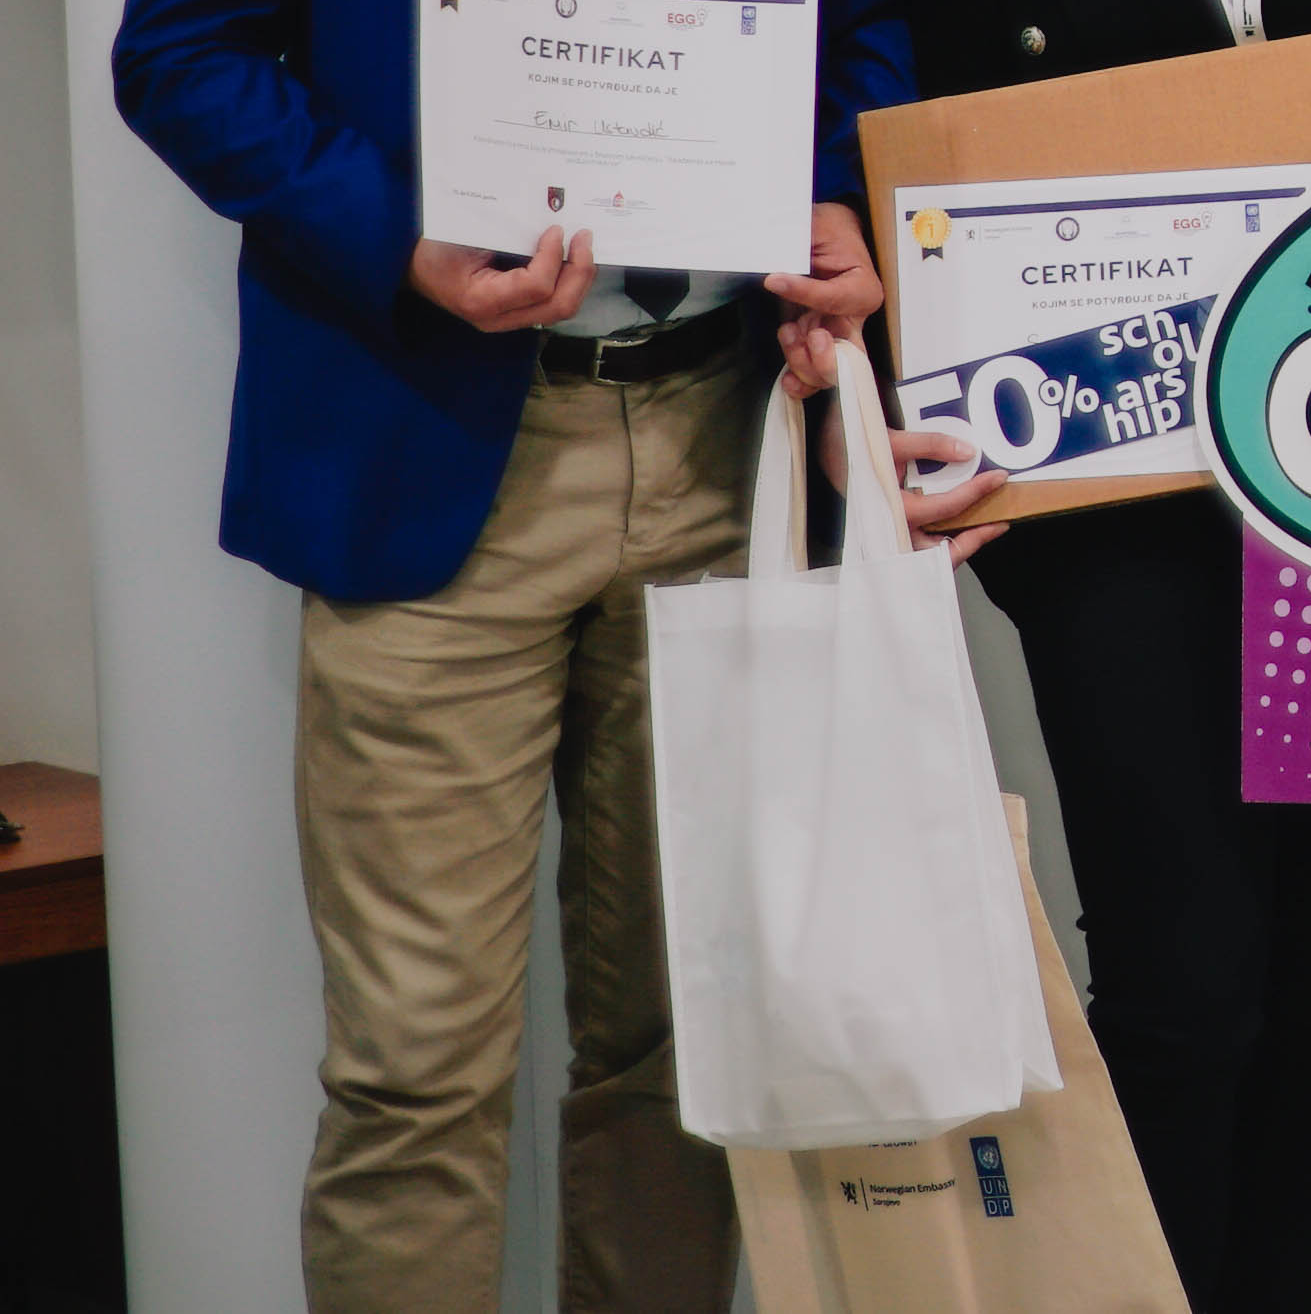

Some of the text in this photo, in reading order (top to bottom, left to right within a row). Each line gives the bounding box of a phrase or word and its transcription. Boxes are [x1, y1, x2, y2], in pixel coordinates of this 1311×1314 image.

[521, 35, 687, 72] CERTIFIKAT
[528, 72, 560, 85] KOJIM
[562, 77, 575, 87] SE
[1172, 218, 1201, 231] EGG
[1021, 256, 1194, 286] CERTIFIKAT
[1032, 298, 1068, 310] KOJIM
[1070, 297, 1085, 308] SE
[1157, 292, 1173, 303] DA
[1175, 291, 1190, 302] JE
[1099, 310, 1179, 357] sch
[1118, 367, 1187, 413] ars
[896, 353, 1101, 496] 50%
[1102, 397, 1183, 445] hip
